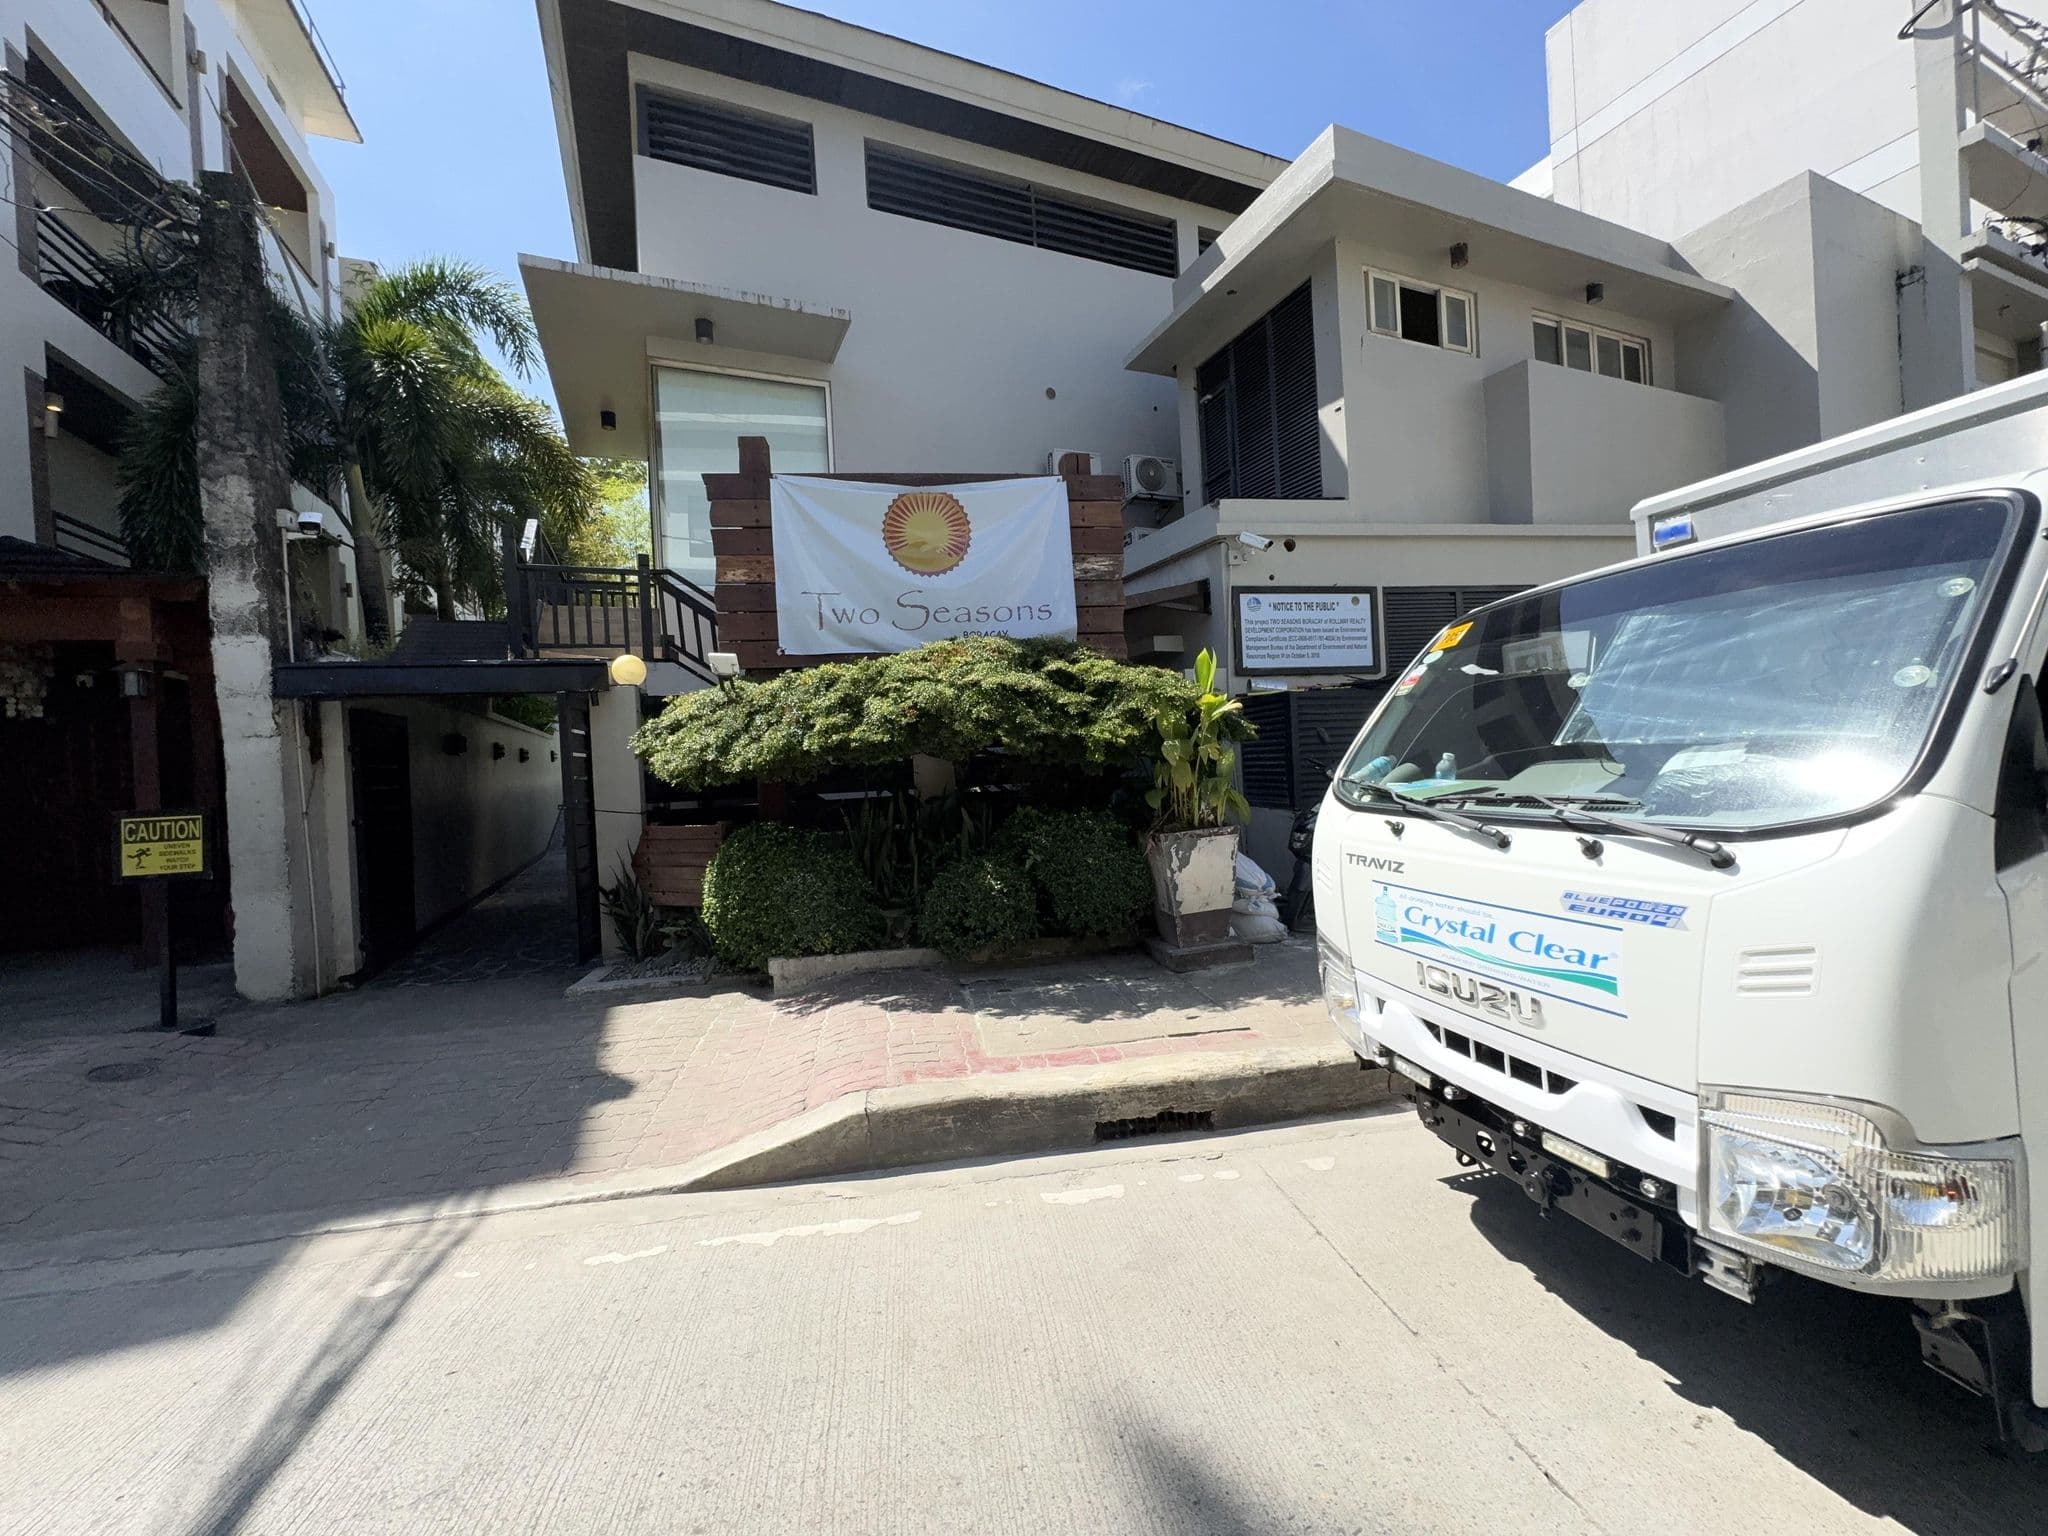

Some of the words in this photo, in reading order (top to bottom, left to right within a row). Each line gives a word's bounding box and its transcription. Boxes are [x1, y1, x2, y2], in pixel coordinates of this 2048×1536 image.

[801, 590, 880, 631] Two
[892, 589, 1054, 631] Seasons
[1272, 602, 1294, 611] NOTICE
[1294, 602, 1302, 611] TO
[1303, 602, 1315, 611] THE
[1315, 602, 1336, 611] PUBLIC
[124, 820, 200, 842] CAUTION
[1346, 853, 1405, 874] TRAVIZ
[1404, 906, 1496, 944] Crystal
[1508, 928, 1609, 969] Clear
[1417, 961, 1545, 1029] ISUZU
